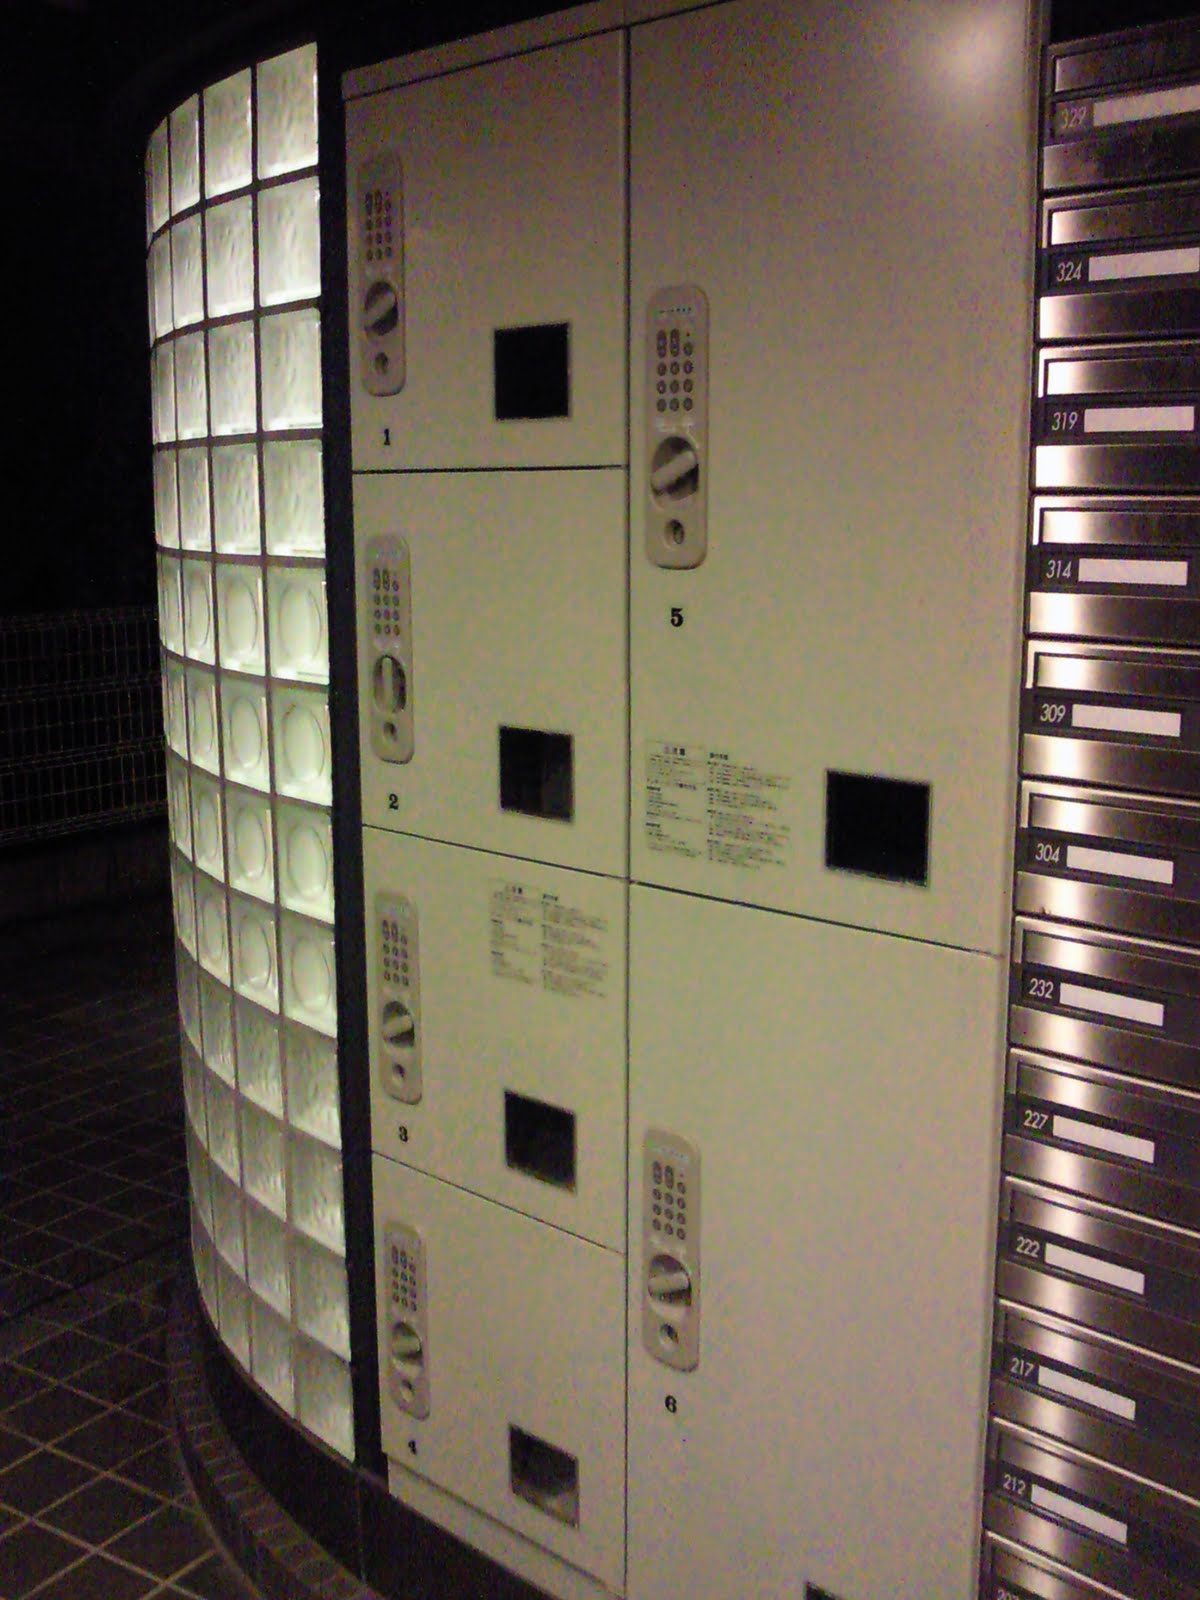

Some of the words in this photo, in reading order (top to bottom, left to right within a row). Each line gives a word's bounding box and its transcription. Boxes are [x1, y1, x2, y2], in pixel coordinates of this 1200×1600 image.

[1056, 261, 1082, 282] 324
[1051, 411, 1078, 431] 319
[383, 428, 391, 446] 1
[1046, 560, 1072, 579] 314
[670, 607, 684, 627] 5
[1040, 703, 1066, 723] 309
[387, 793, 399, 810] 2
[1035, 842, 1060, 863] 304
[1028, 977, 1054, 1000] 232
[1023, 1109, 1049, 1130] 227
[398, 1125, 409, 1143] 3
[1015, 1235, 1040, 1258] 222
[1010, 1357, 1034, 1378] 217
[664, 1394, 678, 1414] 6
[1003, 1473, 1026, 1496] 212
